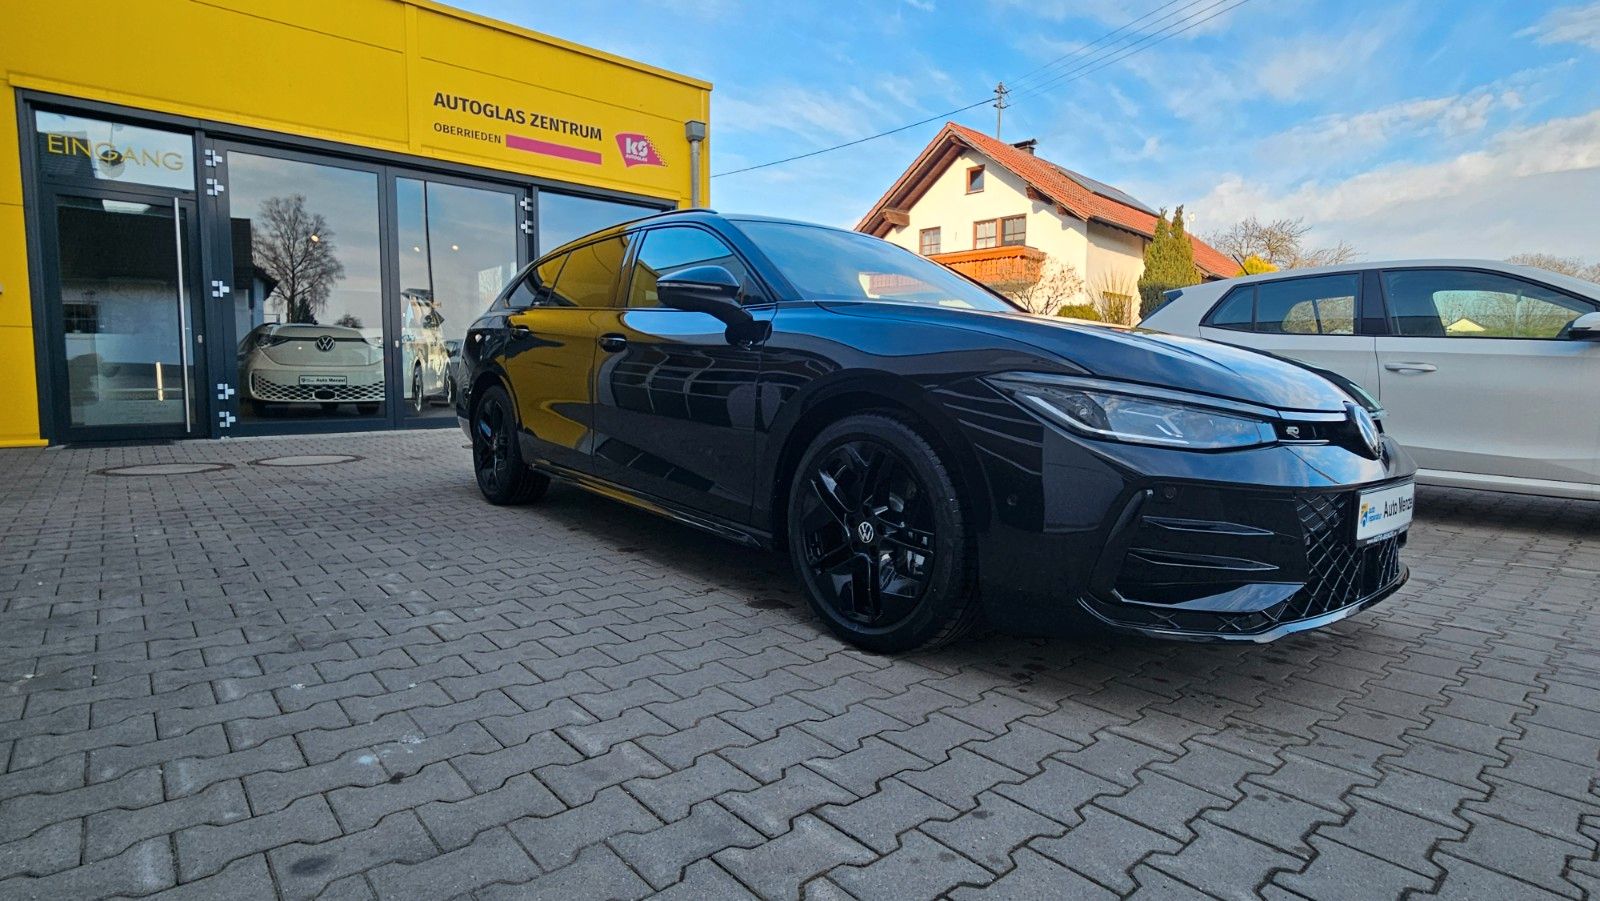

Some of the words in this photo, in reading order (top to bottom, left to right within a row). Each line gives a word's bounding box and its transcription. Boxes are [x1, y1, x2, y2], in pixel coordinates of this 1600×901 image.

[433, 92, 526, 125] AUTOGLAS
[530, 113, 602, 141] ZENTRUM
[433, 122, 502, 144] OBERRIEDEN
[48, 133, 184, 171] EINGANG
[1383, 500, 1397, 518] Auto
